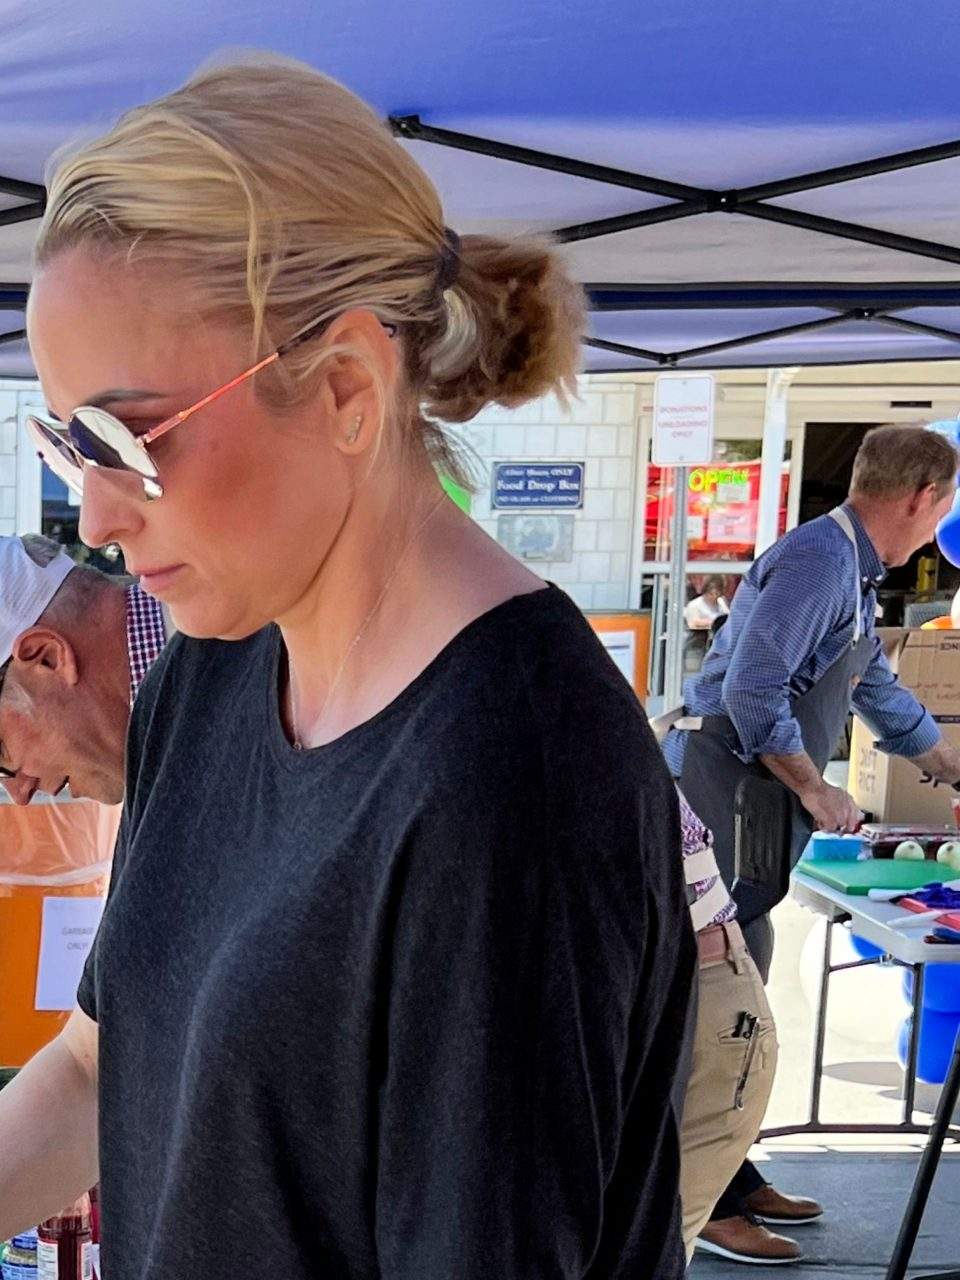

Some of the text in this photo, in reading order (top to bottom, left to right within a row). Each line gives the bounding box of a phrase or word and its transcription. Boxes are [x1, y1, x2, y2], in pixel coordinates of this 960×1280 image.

[497, 479, 579, 493] Food Drop Box
[688, 468, 749, 492] OPEN
[61, 927, 96, 935] GARBAG
